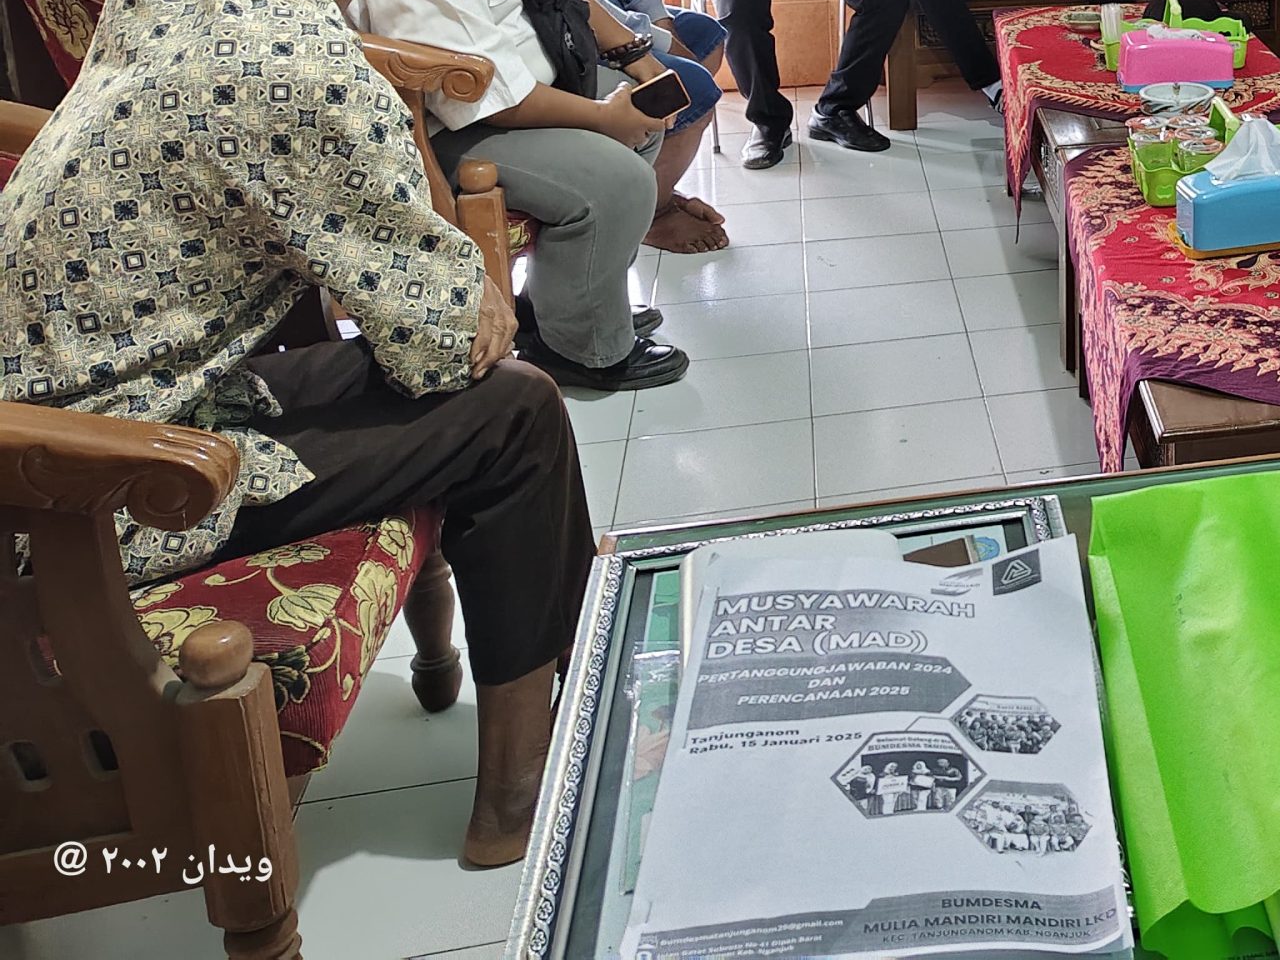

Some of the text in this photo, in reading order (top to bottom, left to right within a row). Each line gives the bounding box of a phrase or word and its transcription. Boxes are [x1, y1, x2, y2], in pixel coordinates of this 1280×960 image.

[715, 591, 976, 619] MUSYAWARAH
[709, 614, 837, 638] ANTAR
[706, 630, 929, 660] DESA (MAD)
[697, 661, 953, 685] PERTANGGUNGJAWABAN 2024
[807, 676, 846, 689] DAN
[737, 686, 911, 706] PERENCANAAN 2025
[690, 729, 800, 746] Tanjunganom
[739, 740, 757, 749] 15
[760, 734, 822, 748] Januari
[825, 732, 862, 742] 2025
[941, 897, 1042, 911] BUMDESMA
[863, 908, 1116, 934] MULIA MANDIRI MANDIRI LKD
[912, 928, 1004, 940] TANJUNGANOM
[1035, 929, 1091, 939] NGANJUK
